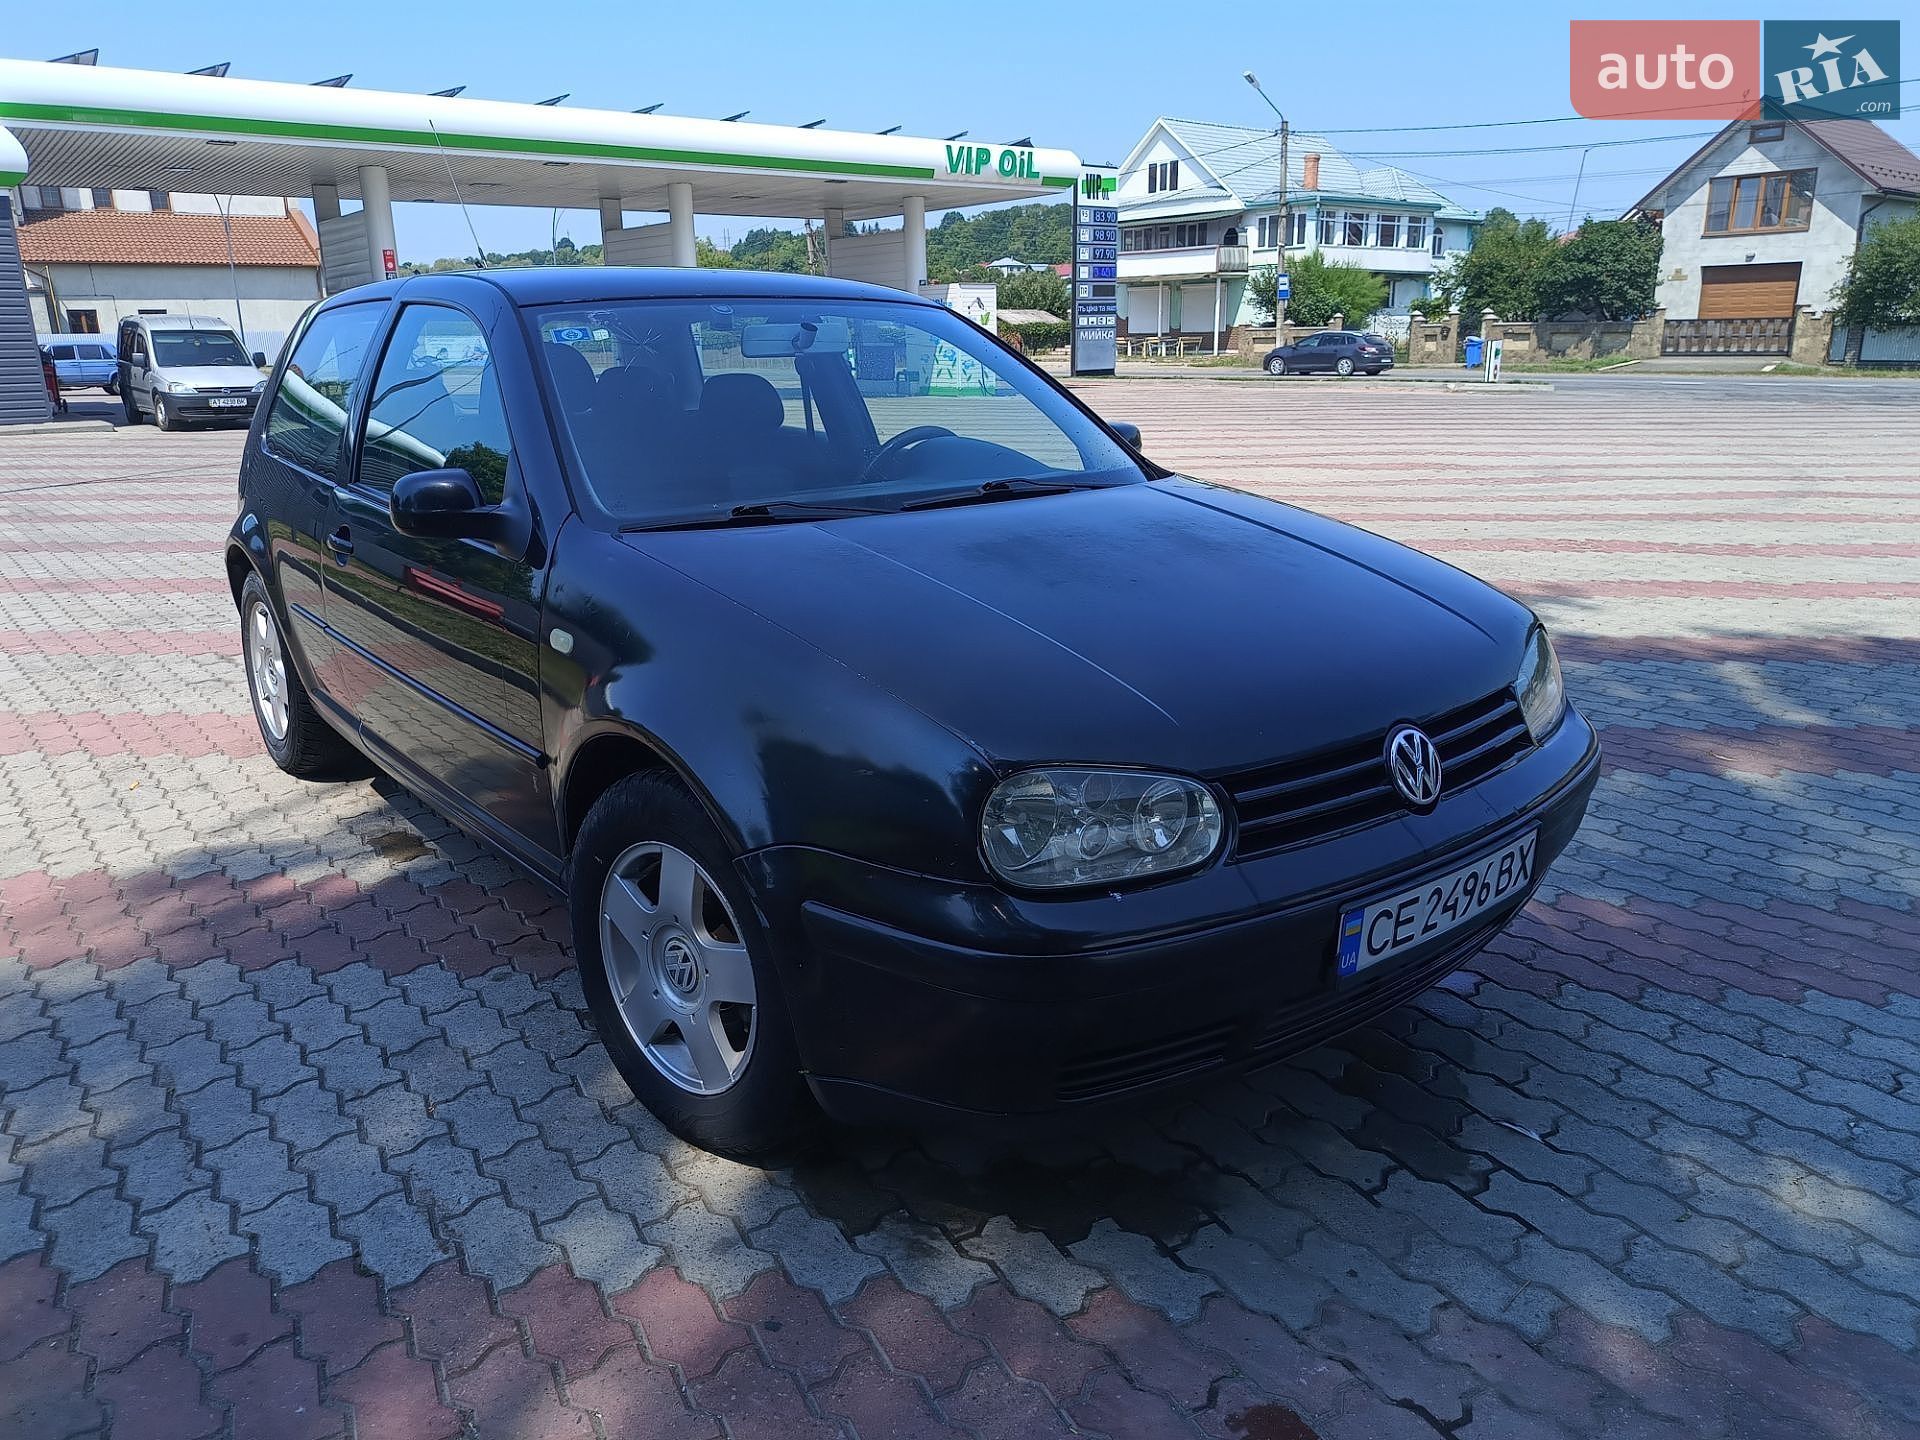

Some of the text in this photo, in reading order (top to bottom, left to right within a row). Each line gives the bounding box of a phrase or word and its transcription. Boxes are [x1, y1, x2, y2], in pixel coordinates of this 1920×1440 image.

[945, 144, 991, 175] VIP
[1086, 173, 1102, 200] VIP
[1095, 230, 1115, 241] 98.90
[1094, 248, 1115, 259] 97.90
[1080, 328, 1114, 340] МИЙКА
[1367, 837, 1535, 956] CE 2496 BX
[1341, 954, 1357, 969] UA
